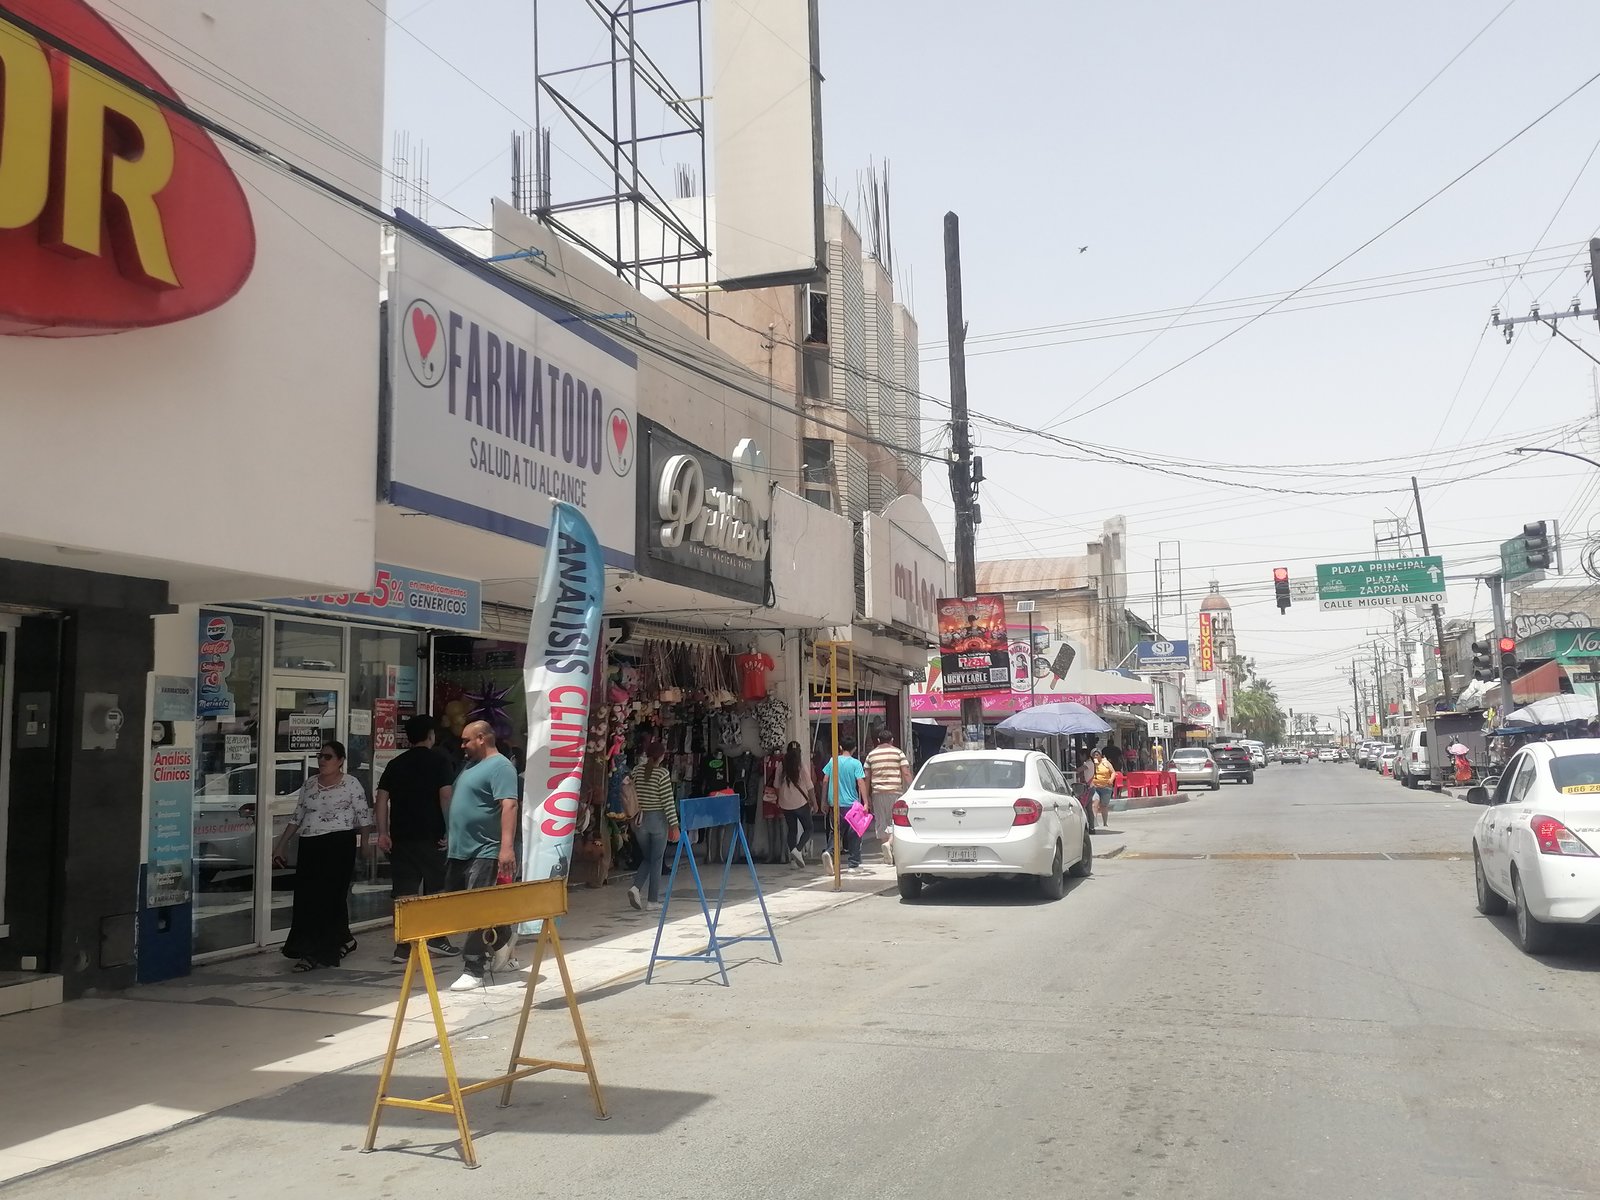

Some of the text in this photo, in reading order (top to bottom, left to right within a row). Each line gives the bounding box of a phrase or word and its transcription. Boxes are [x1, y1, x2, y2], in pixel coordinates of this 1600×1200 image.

[448, 309, 603, 476] FARMATODO
[469, 436, 587, 508] SALUD A TU ALCANCE
[1331, 560, 1426, 575] PLAZA PRINCIPAL
[1365, 574, 1399, 584] PLAZA
[419, 582, 468, 597] medicamentos
[1359, 584, 1409, 595] ZAPOPAN
[409, 593, 468, 615] GENÉRICOS
[1323, 600, 1353, 609] CALLE
[1358, 597, 1397, 607] MIGUEL
[1402, 594, 1443, 604] BLANCO
[1155, 643, 1171, 653] SP
[1200, 614, 1212, 671] LUXOR
[943, 674, 966, 685] LUCKY
[966, 672, 988, 683] EAGLE
[1153, 722, 1159, 731] E
[153, 751, 191, 766] Análisis
[153, 767, 190, 782] Clínicos
[1567, 786, 1586, 794] 866
